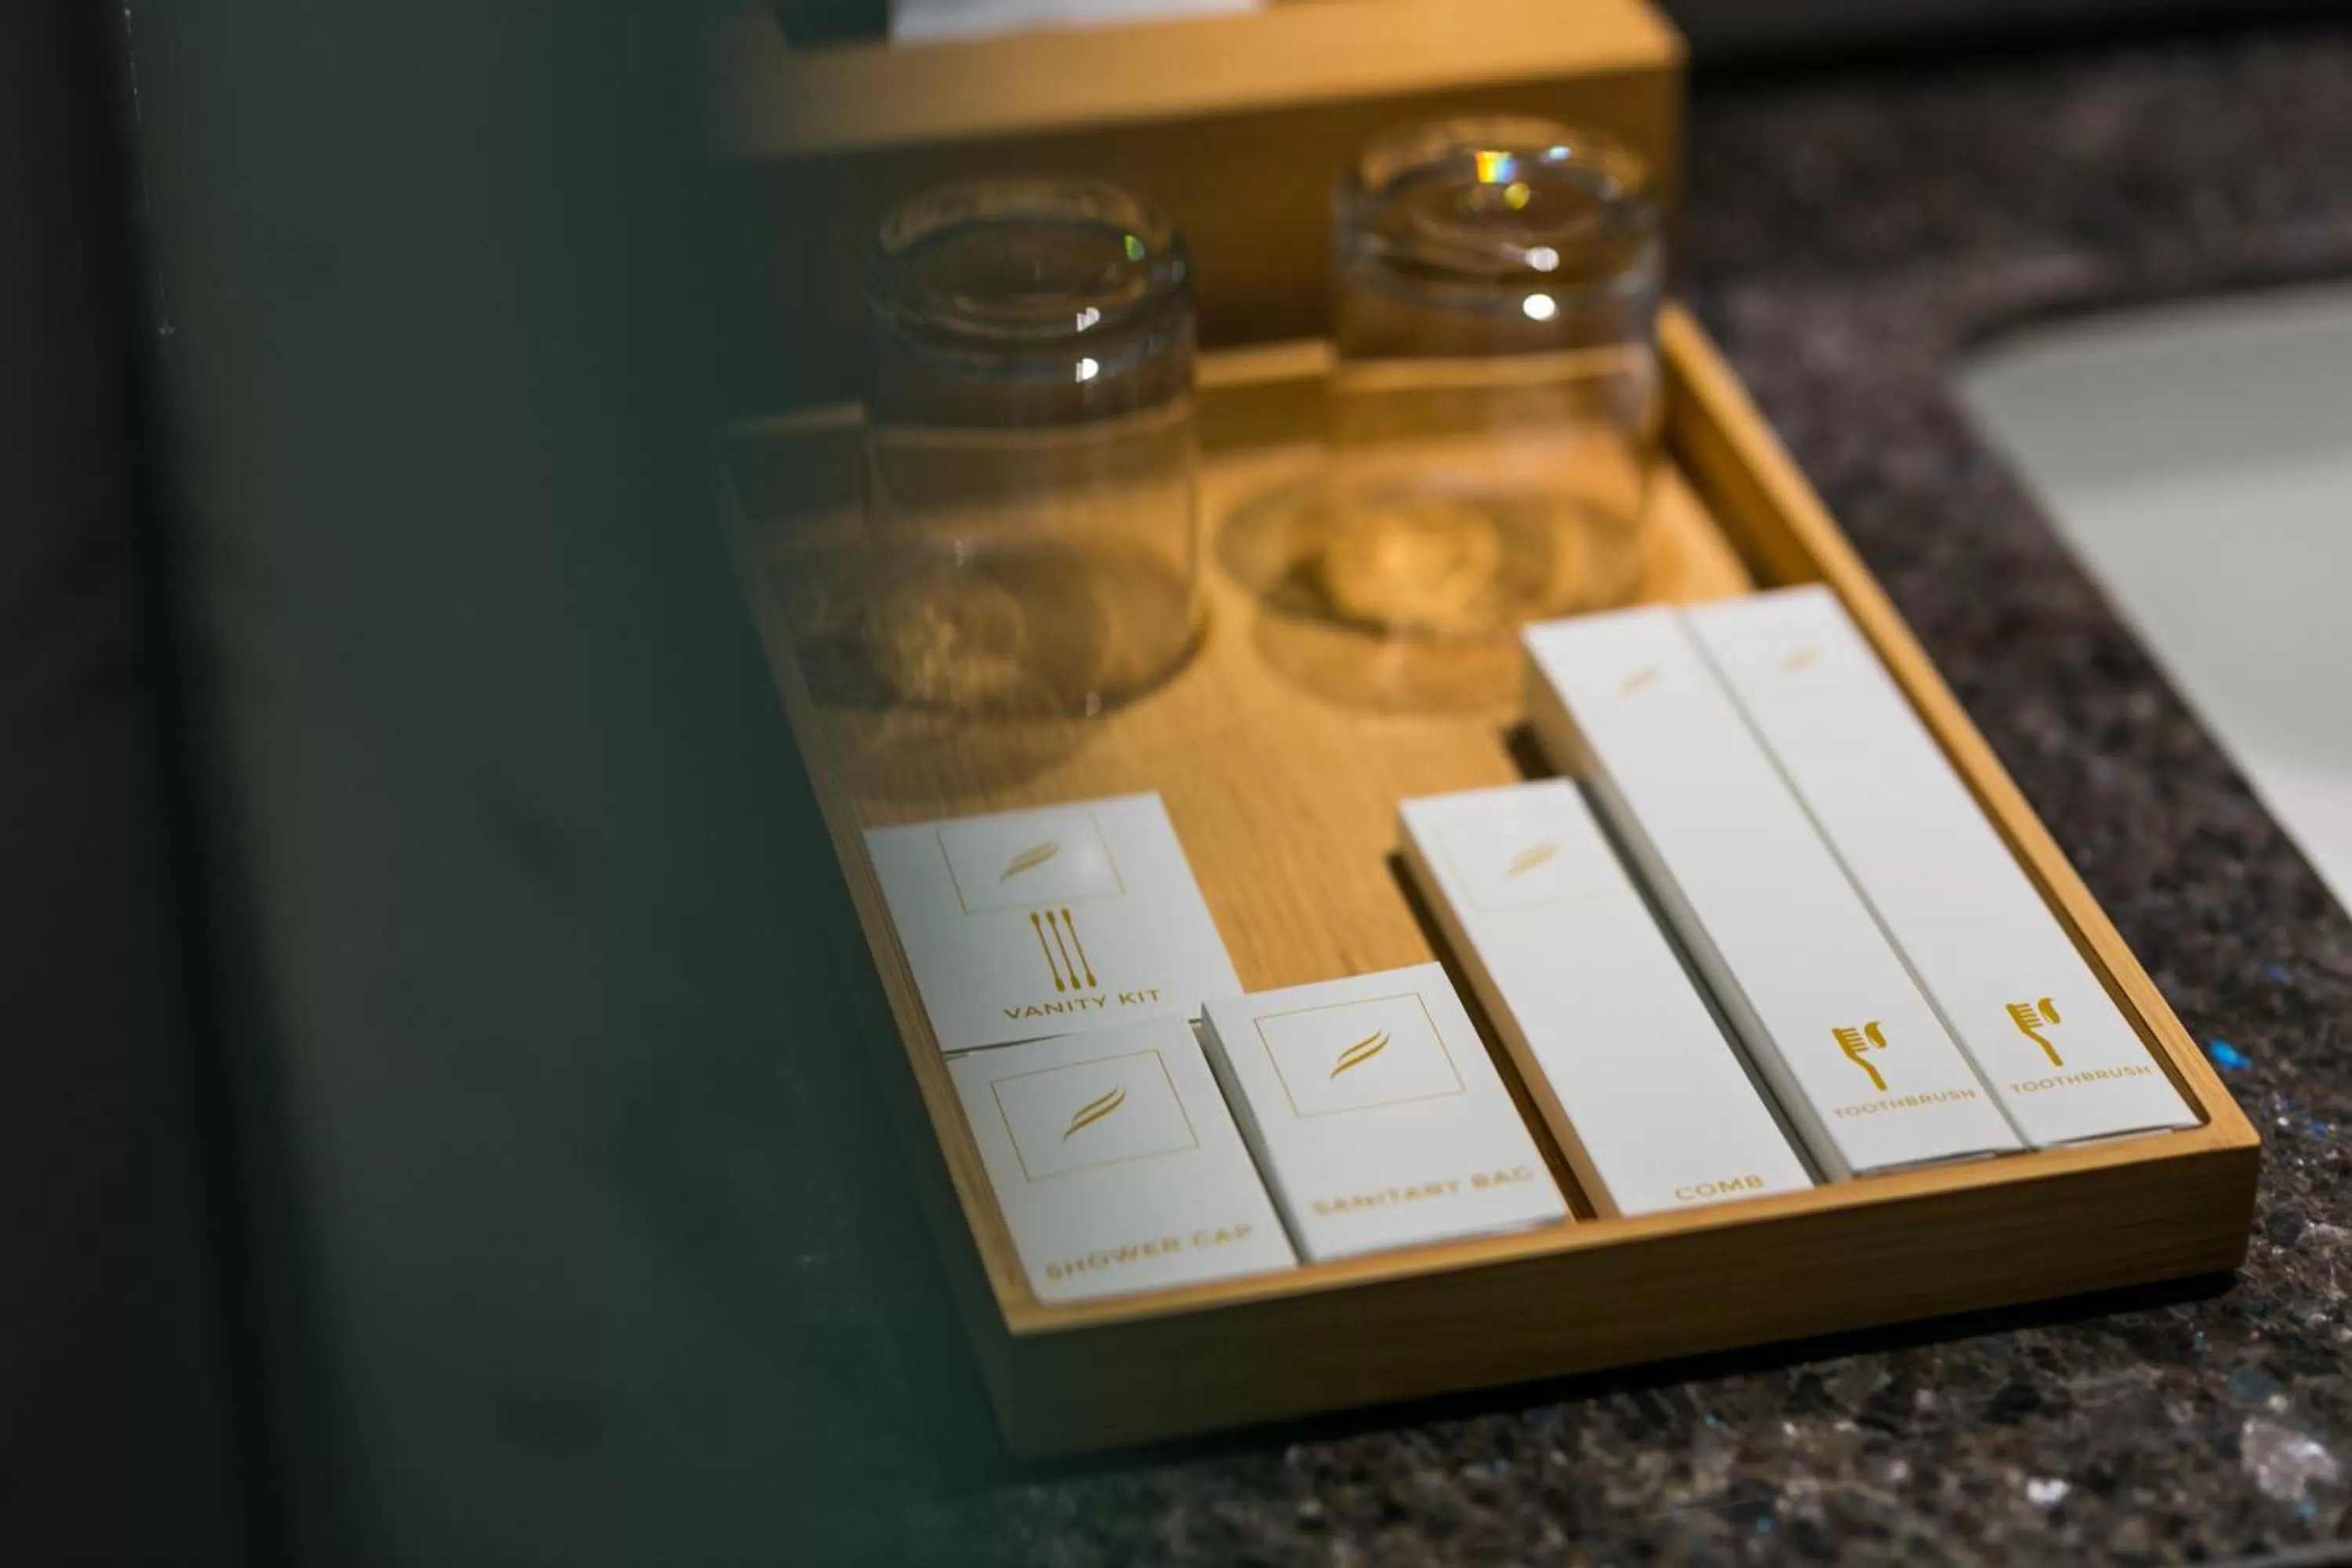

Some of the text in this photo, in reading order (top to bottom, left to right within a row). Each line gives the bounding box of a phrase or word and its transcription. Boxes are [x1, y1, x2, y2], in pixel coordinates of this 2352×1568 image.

[1004, 989, 1161, 1019] VANITY KIT
[2008, 1064, 2153, 1094] TOOTHBRUSH
[1832, 1088, 1976, 1119] TOOTHBRUSH
[1674, 1174, 1765, 1200] COMB
[1047, 1236, 1180, 1280] SHOWER
